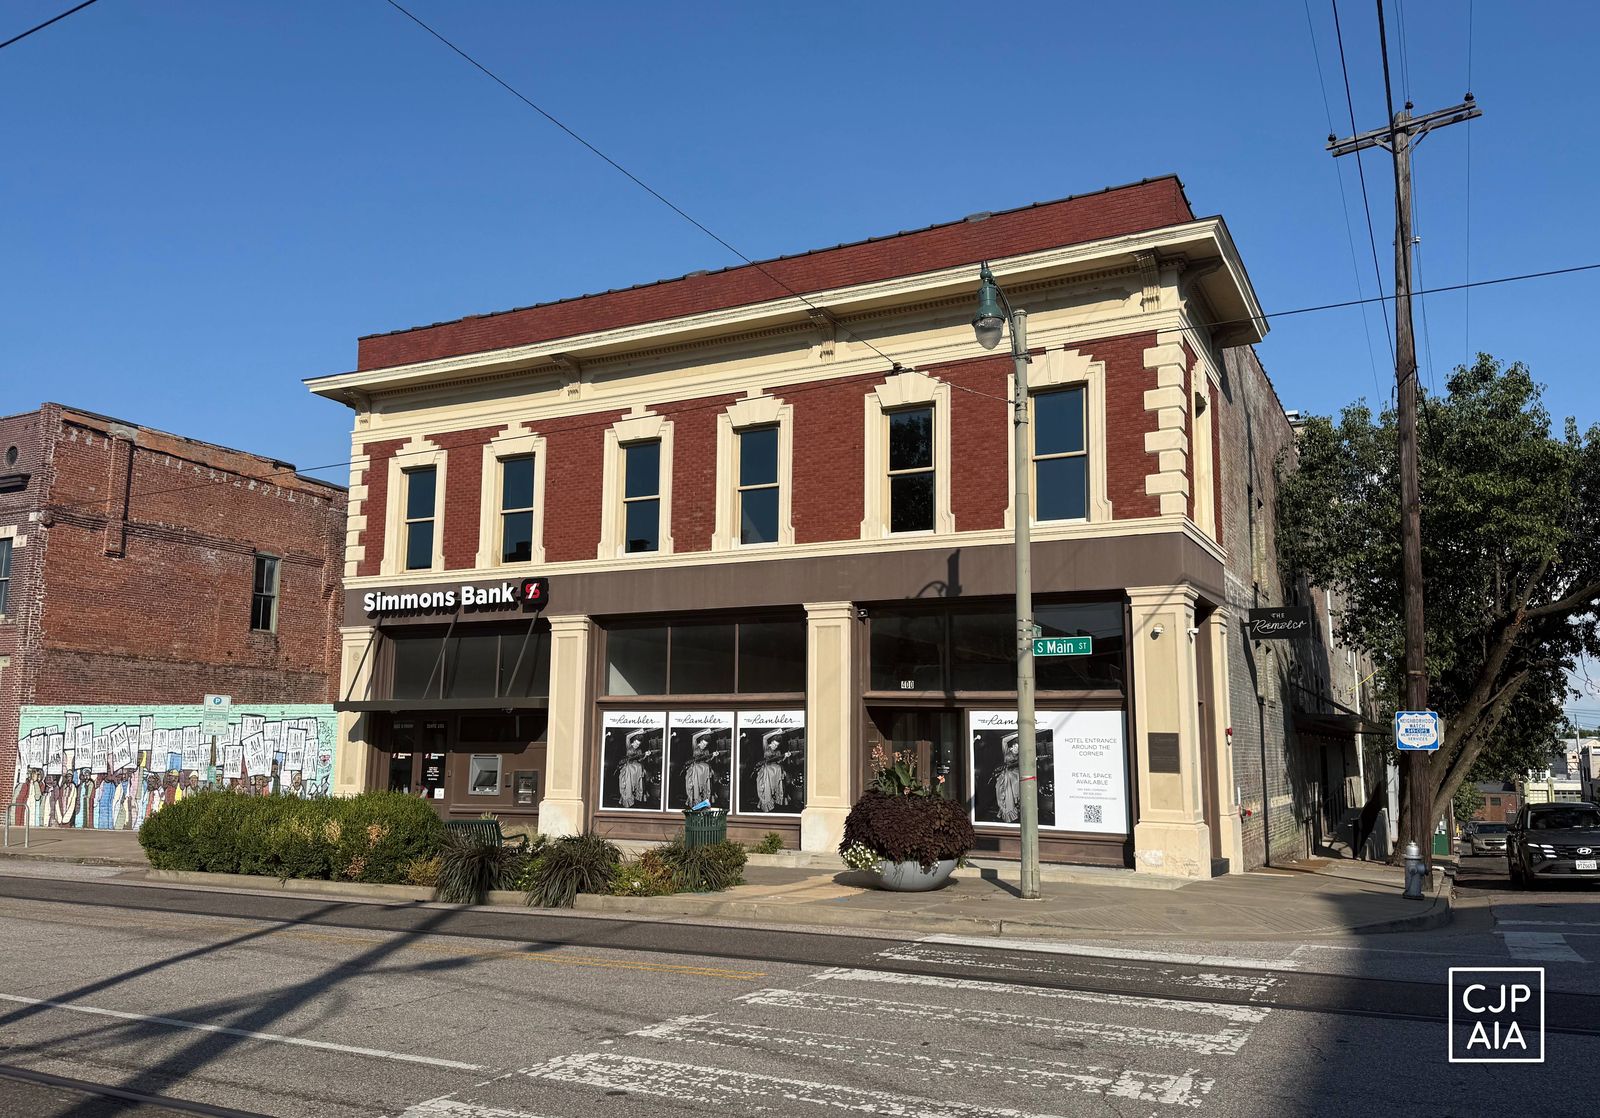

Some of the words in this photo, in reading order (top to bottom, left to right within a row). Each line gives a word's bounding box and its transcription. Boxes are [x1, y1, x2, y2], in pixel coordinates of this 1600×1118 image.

[363, 588, 455, 612] Simmons
[461, 582, 515, 606] Bank
[1037, 641, 1044, 653] S
[1046, 640, 1074, 653] Main
[1078, 642, 1087, 650] ST
[616, 714, 657, 724] Rambler
[751, 714, 794, 724] Rambler
